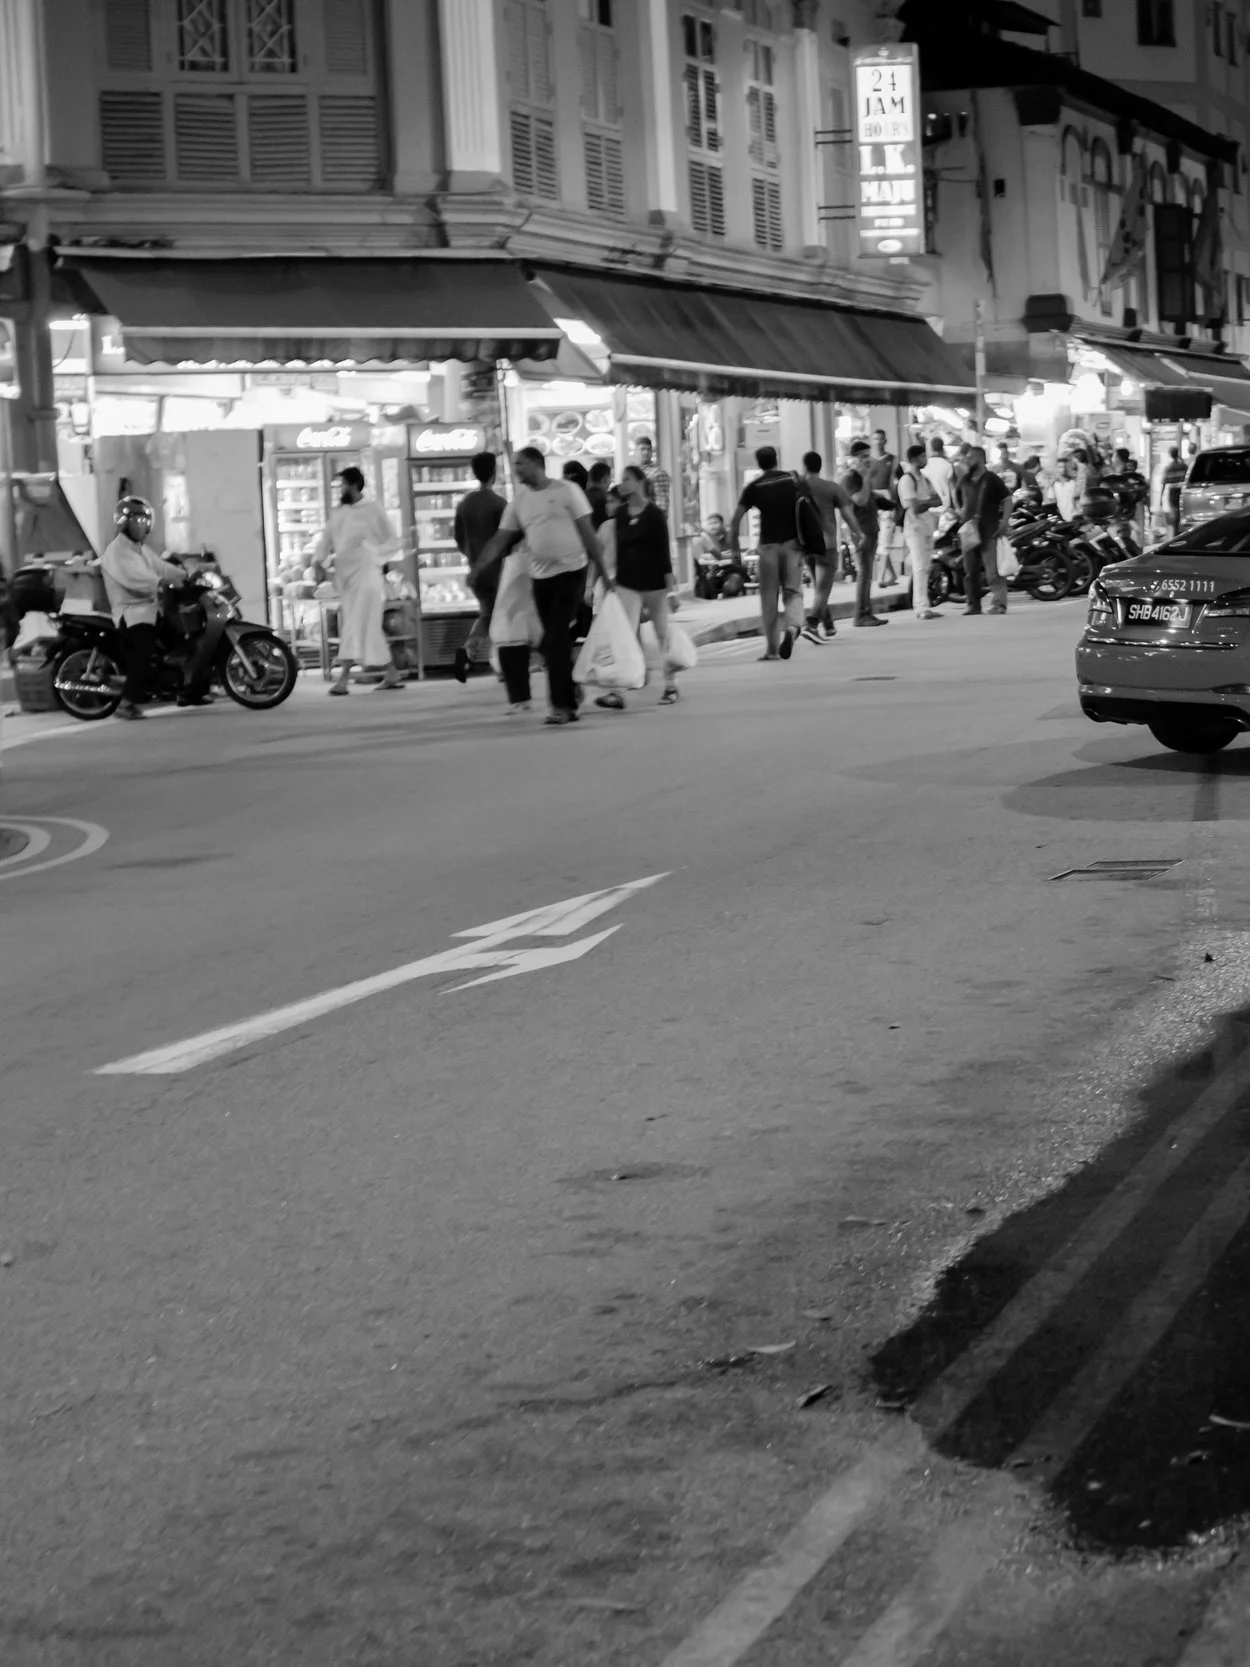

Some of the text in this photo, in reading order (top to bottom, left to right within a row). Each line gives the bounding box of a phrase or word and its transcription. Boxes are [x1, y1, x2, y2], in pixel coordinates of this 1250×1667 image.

[872, 69, 896, 91] 24
[863, 96, 904, 117] JAM
[860, 179, 915, 204] MAJU
[1161, 579, 1214, 592] 6552 1111
[1128, 604, 1190, 621] SHB4162J
